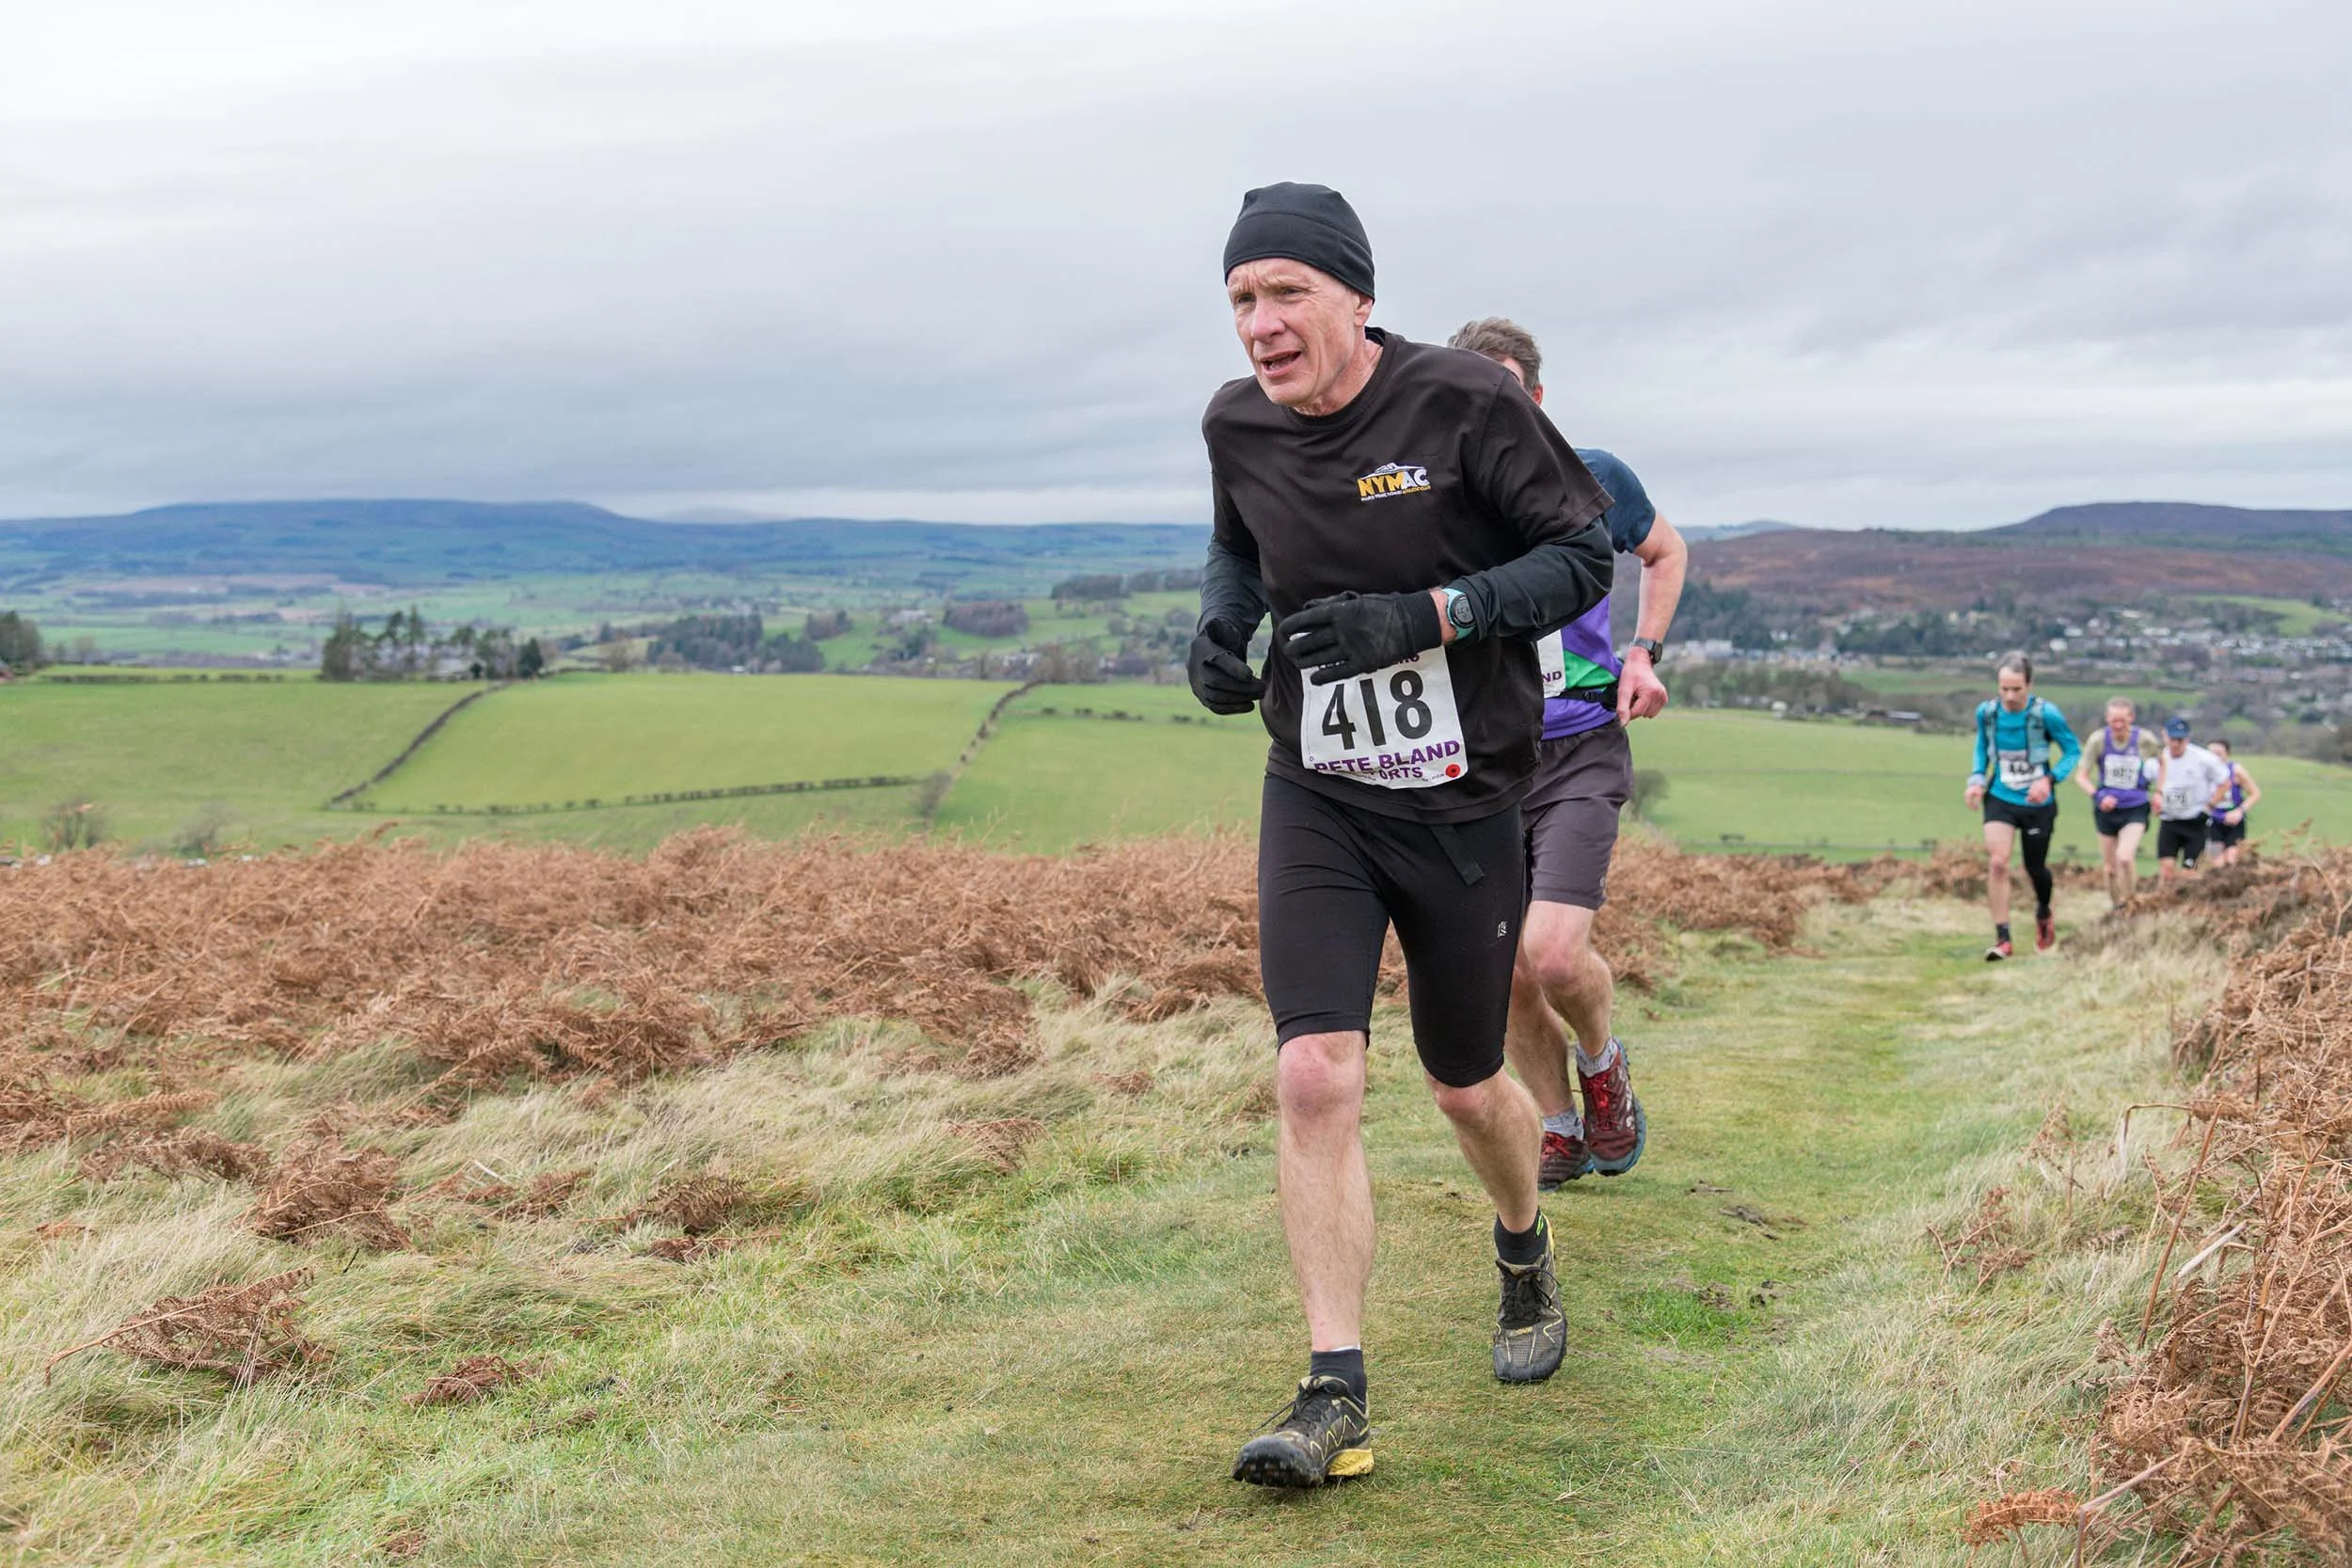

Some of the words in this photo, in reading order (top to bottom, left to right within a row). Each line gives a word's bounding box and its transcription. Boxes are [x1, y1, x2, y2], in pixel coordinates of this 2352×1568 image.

[1357, 468, 1430, 497] NYMAC
[1321, 670, 1433, 751] 418
[1314, 756, 1372, 772] PETE
[1377, 739, 1460, 769] BLAND
[1372, 766, 1423, 781] ORTS
